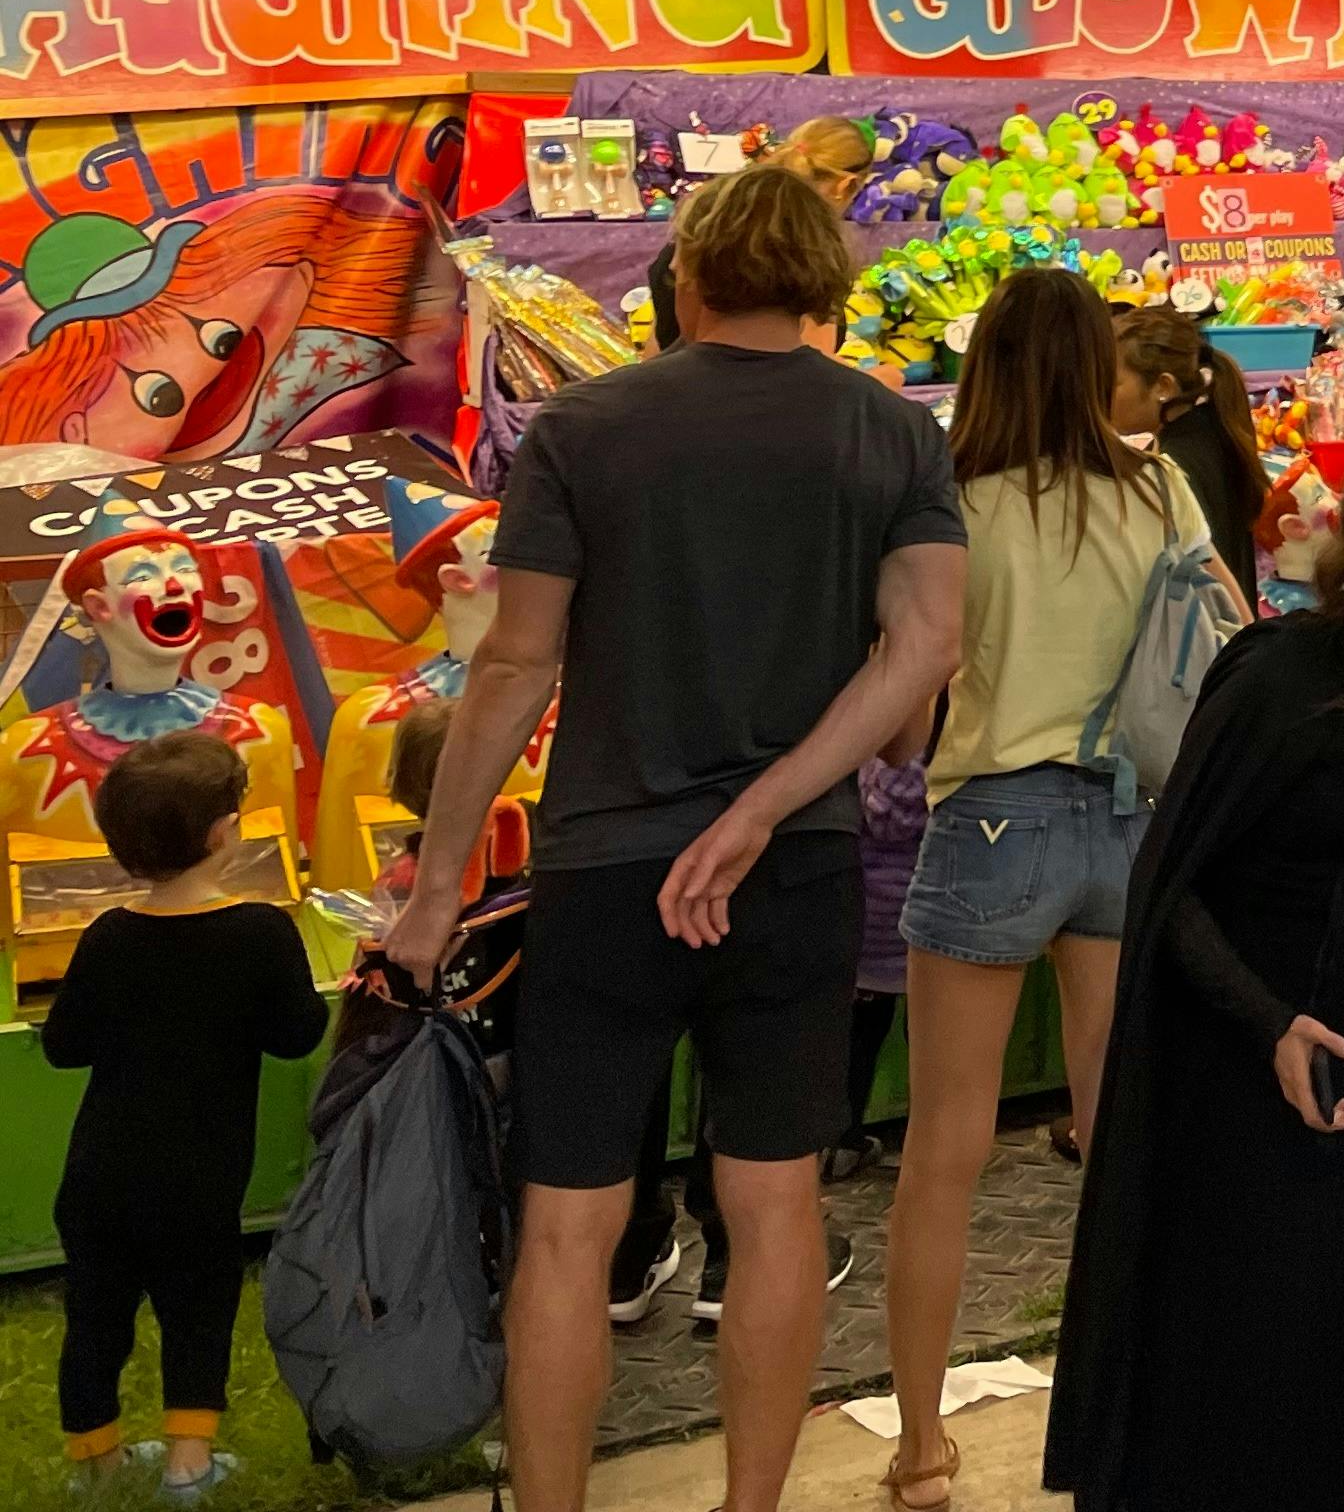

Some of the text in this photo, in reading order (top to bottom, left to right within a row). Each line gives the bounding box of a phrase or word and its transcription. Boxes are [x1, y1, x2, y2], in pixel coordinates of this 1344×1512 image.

[1078, 98, 1117, 124] 29
[696, 139, 720, 168] 7
[1179, 241, 1222, 263] CASH
[1264, 236, 1336, 259] COUPONS
[166, 486, 370, 540] CASH
